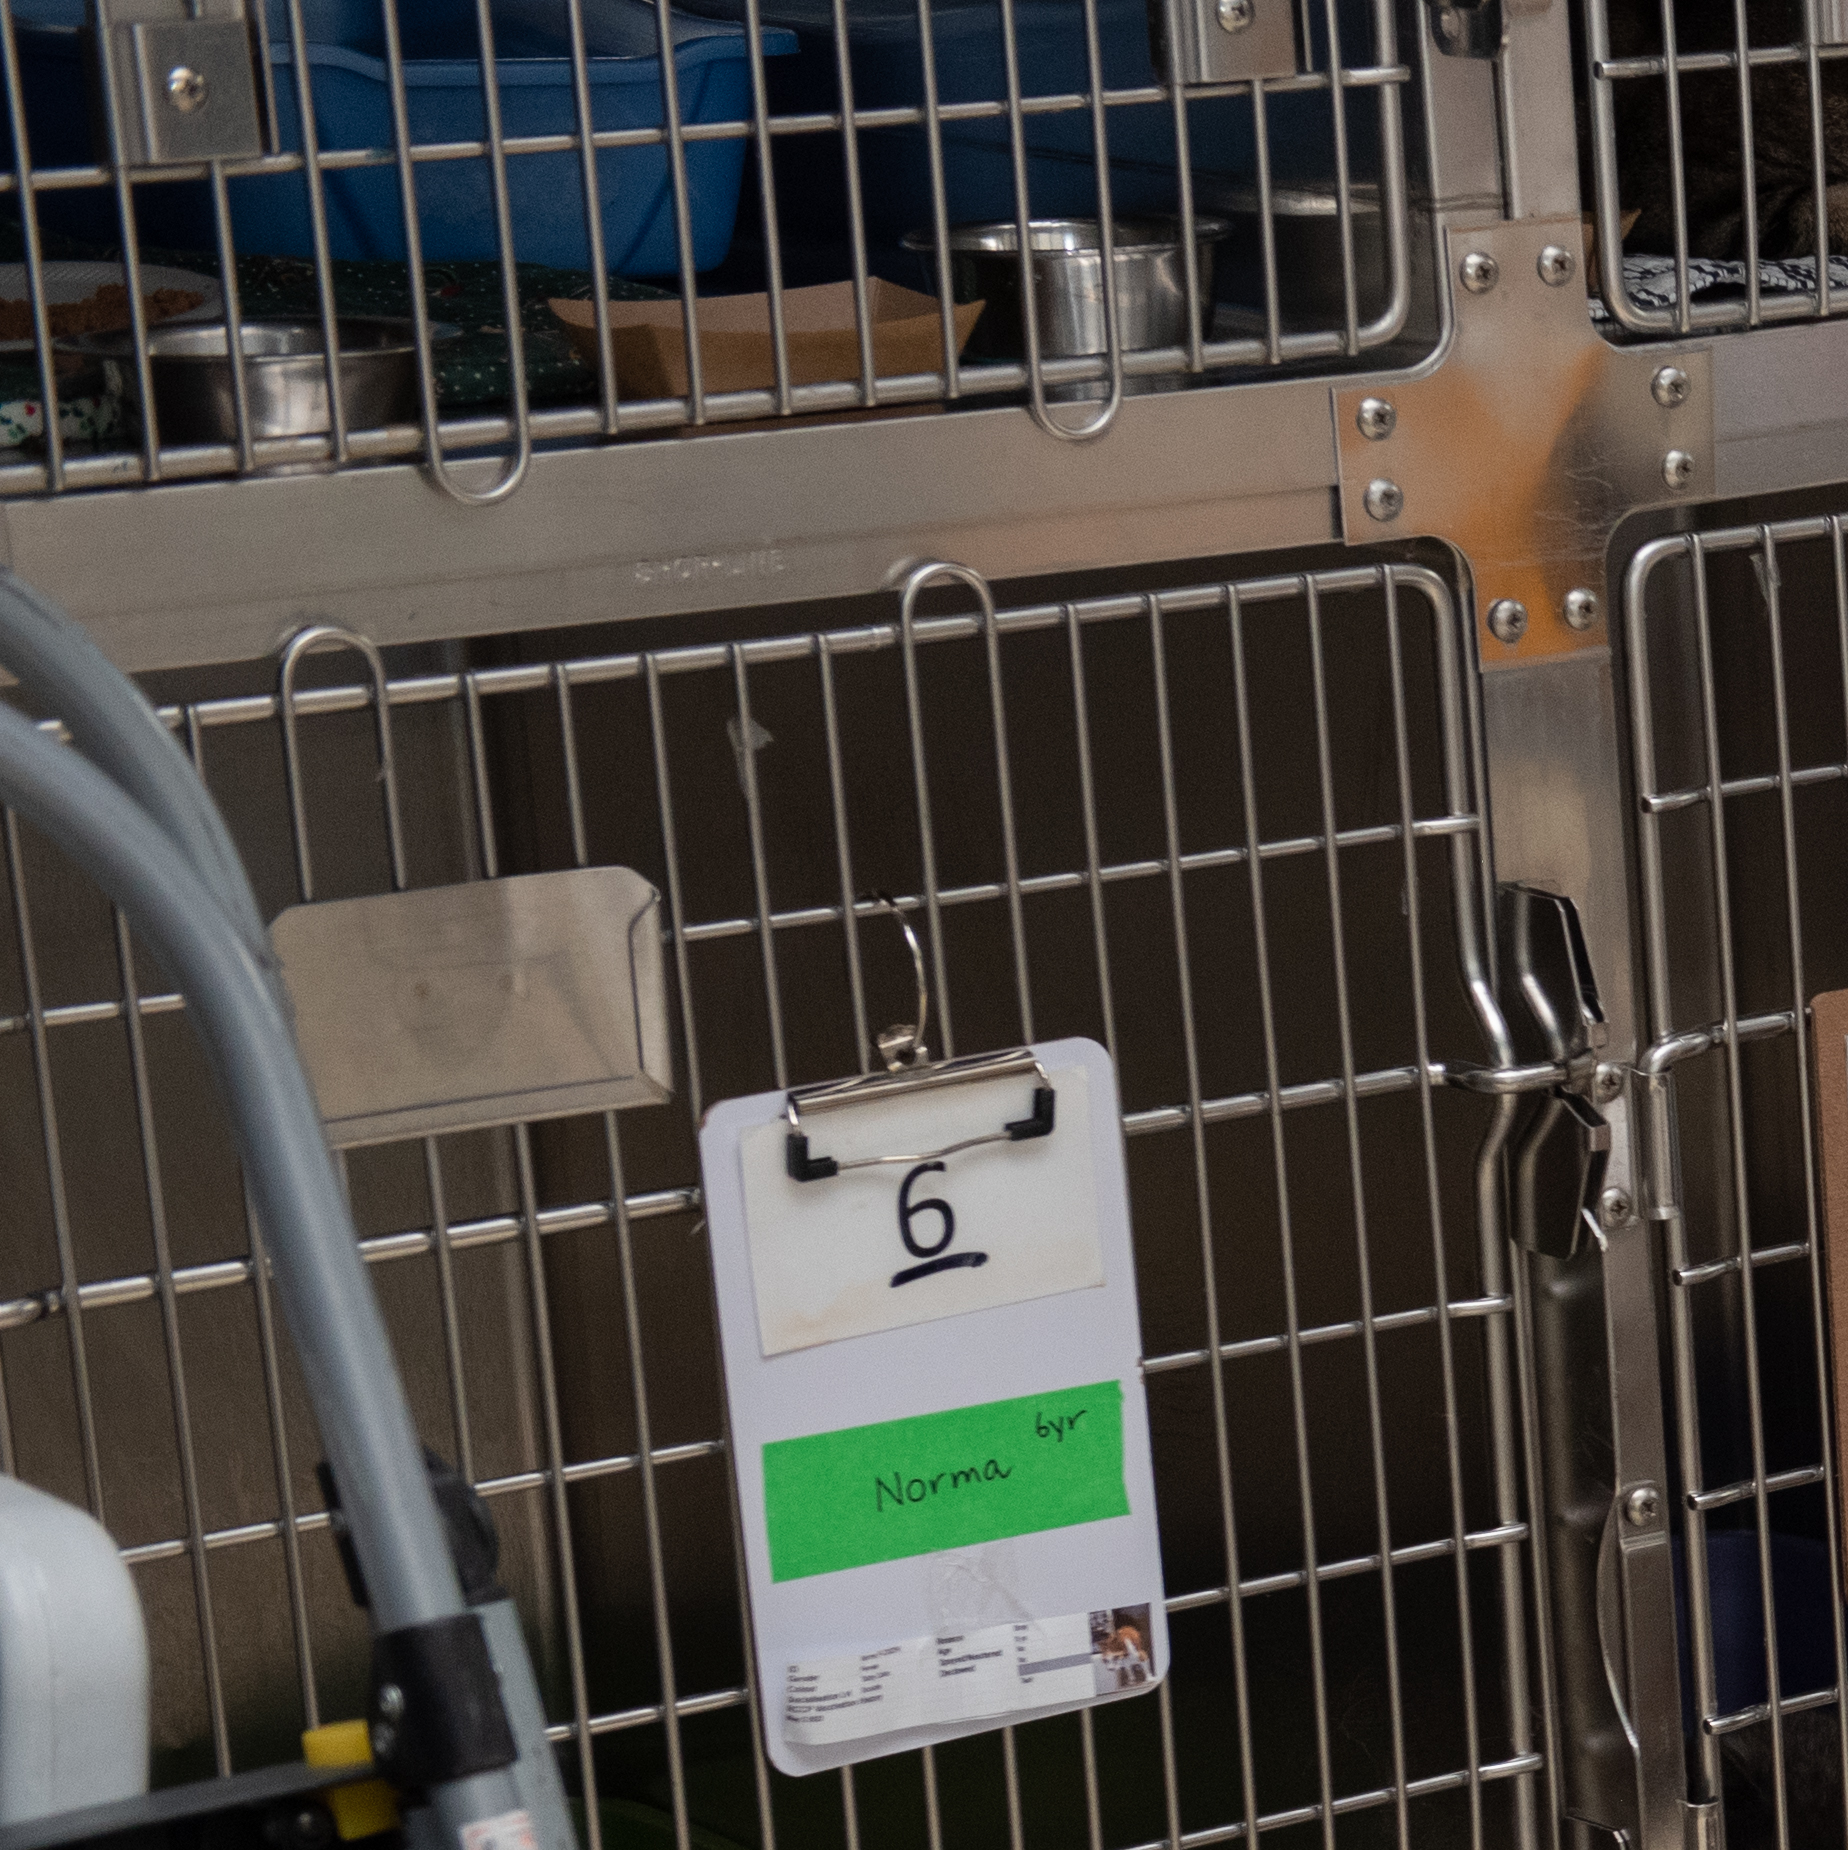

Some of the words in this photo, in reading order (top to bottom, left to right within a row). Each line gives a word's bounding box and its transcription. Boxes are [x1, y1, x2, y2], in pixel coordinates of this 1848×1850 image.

[898, 1161, 954, 1258] 6
[1036, 1410, 1088, 1443] 6yr
[876, 1459, 1013, 1512] Norma
